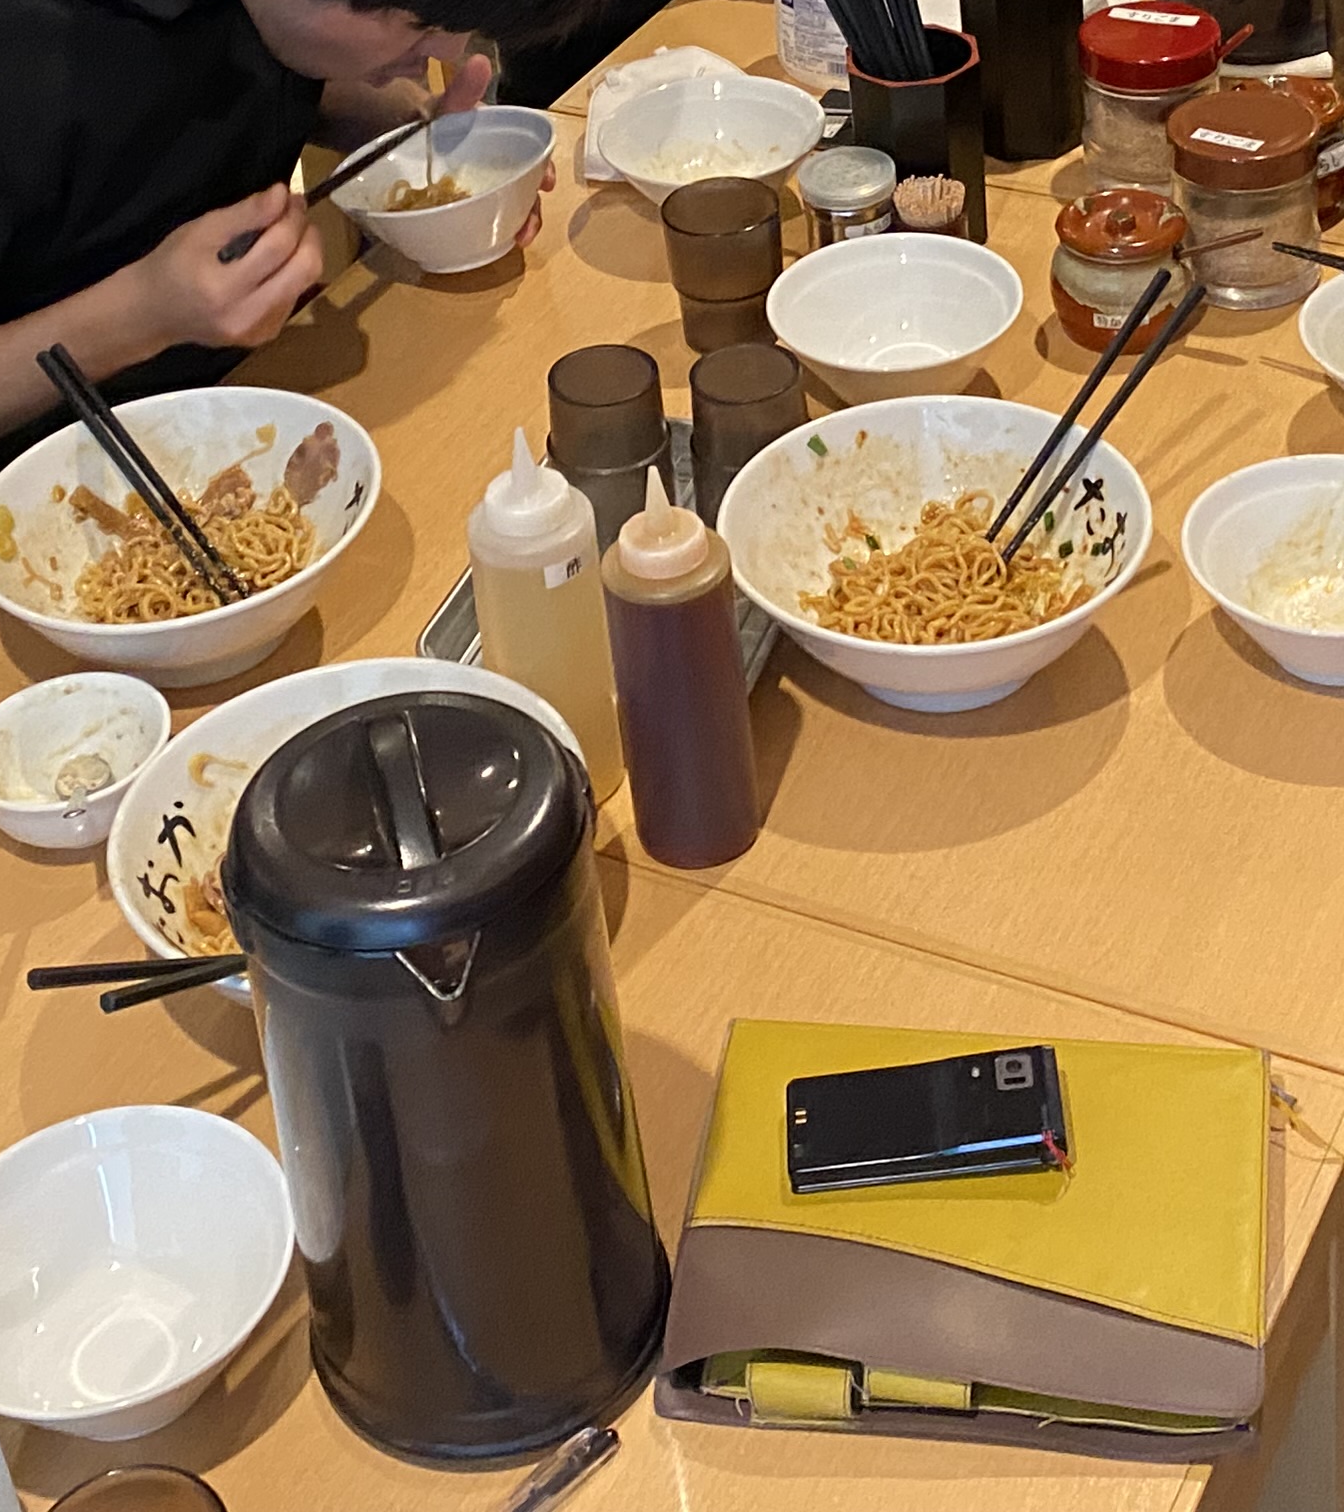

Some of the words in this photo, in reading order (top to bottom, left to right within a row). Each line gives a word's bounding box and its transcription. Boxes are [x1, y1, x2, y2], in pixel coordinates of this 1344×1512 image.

[1128, 10, 1181, 23] すりごま
[1199, 130, 1257, 149] すりごま
